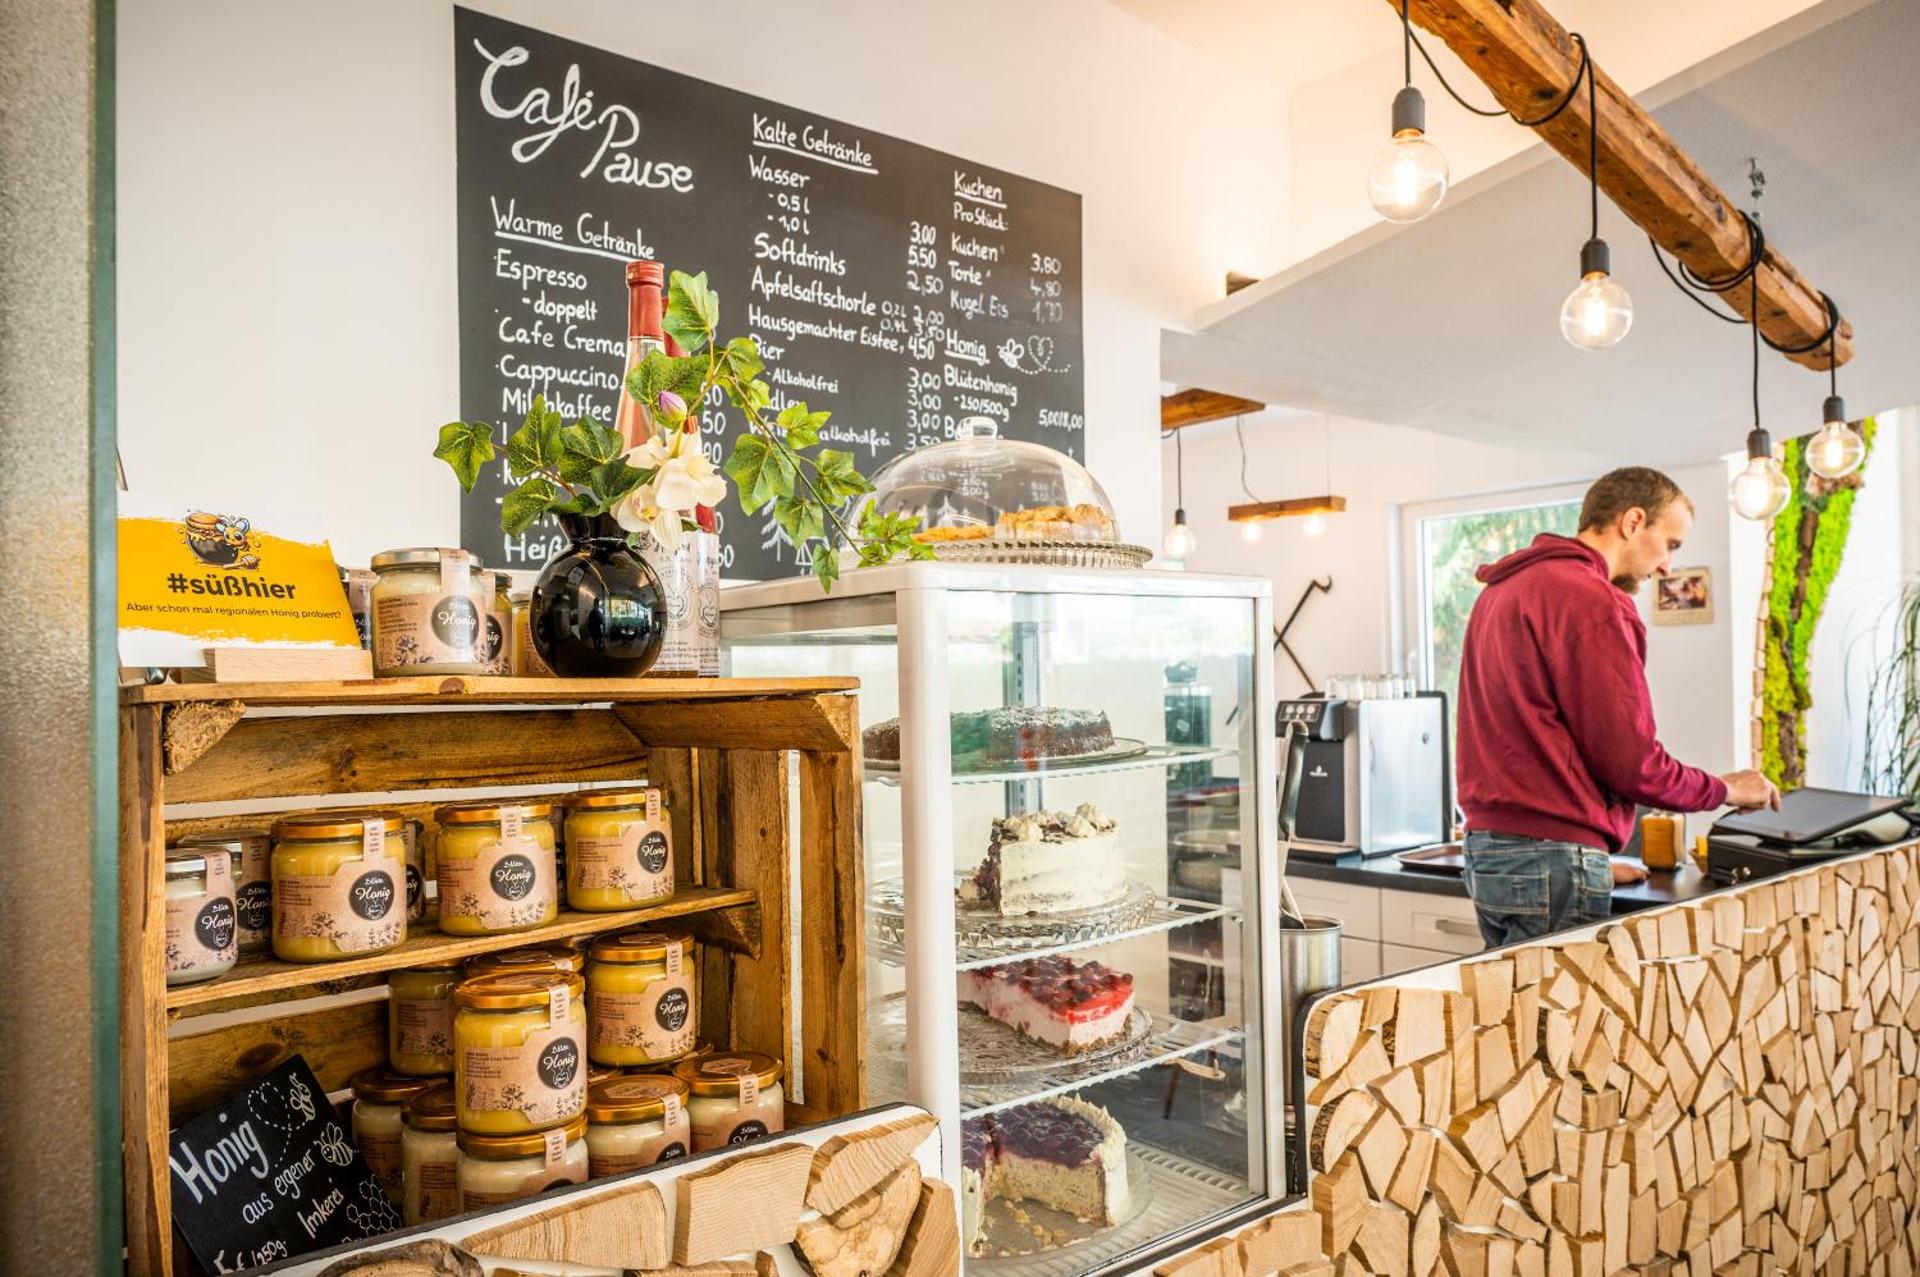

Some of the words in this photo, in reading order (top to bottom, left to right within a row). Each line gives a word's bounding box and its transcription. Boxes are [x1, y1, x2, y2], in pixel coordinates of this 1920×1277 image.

[581, 104, 694, 193] Pause
[753, 113, 797, 148] Kalte
[802, 125, 873, 167] Getränke
[749, 154, 811, 188] Wasser
[954, 170, 1003, 201] Kuchen
[491, 196, 564, 241] Warme
[577, 212, 655, 261] Getränke
[953, 201, 974, 222] Pro
[495, 247, 588, 291] Espresso
[754, 232, 847, 276] Softdrinks
[751, 264, 877, 316] Apfelsaftschorle
[499, 316, 554, 348] Cafe
[564, 325, 626, 358] Crema
[749, 303, 857, 341] Hausgemachter
[947, 327, 987, 366] Honig
[502, 386, 612, 422] Milhkaffee
[944, 363, 1018, 407] Blütenhonig
[818, 425, 892, 456] alkoholfrei
[167, 571, 297, 600] #süßhier
[126, 602, 153, 613] Aber
[156, 604, 190, 614] schon
[192, 606, 213, 615] mal
[215, 607, 269, 618] regionalen
[271, 609, 300, 620] Honig
[355, 886, 391, 902] Honig
[494, 868, 532, 884] Honig
[543, 1052, 577, 1071] Honig
[169, 1112, 270, 1204] Honig
[242, 1191, 274, 1225] aus
[274, 1148, 315, 1200] eigener
[296, 1176, 345, 1240] Imkerei
